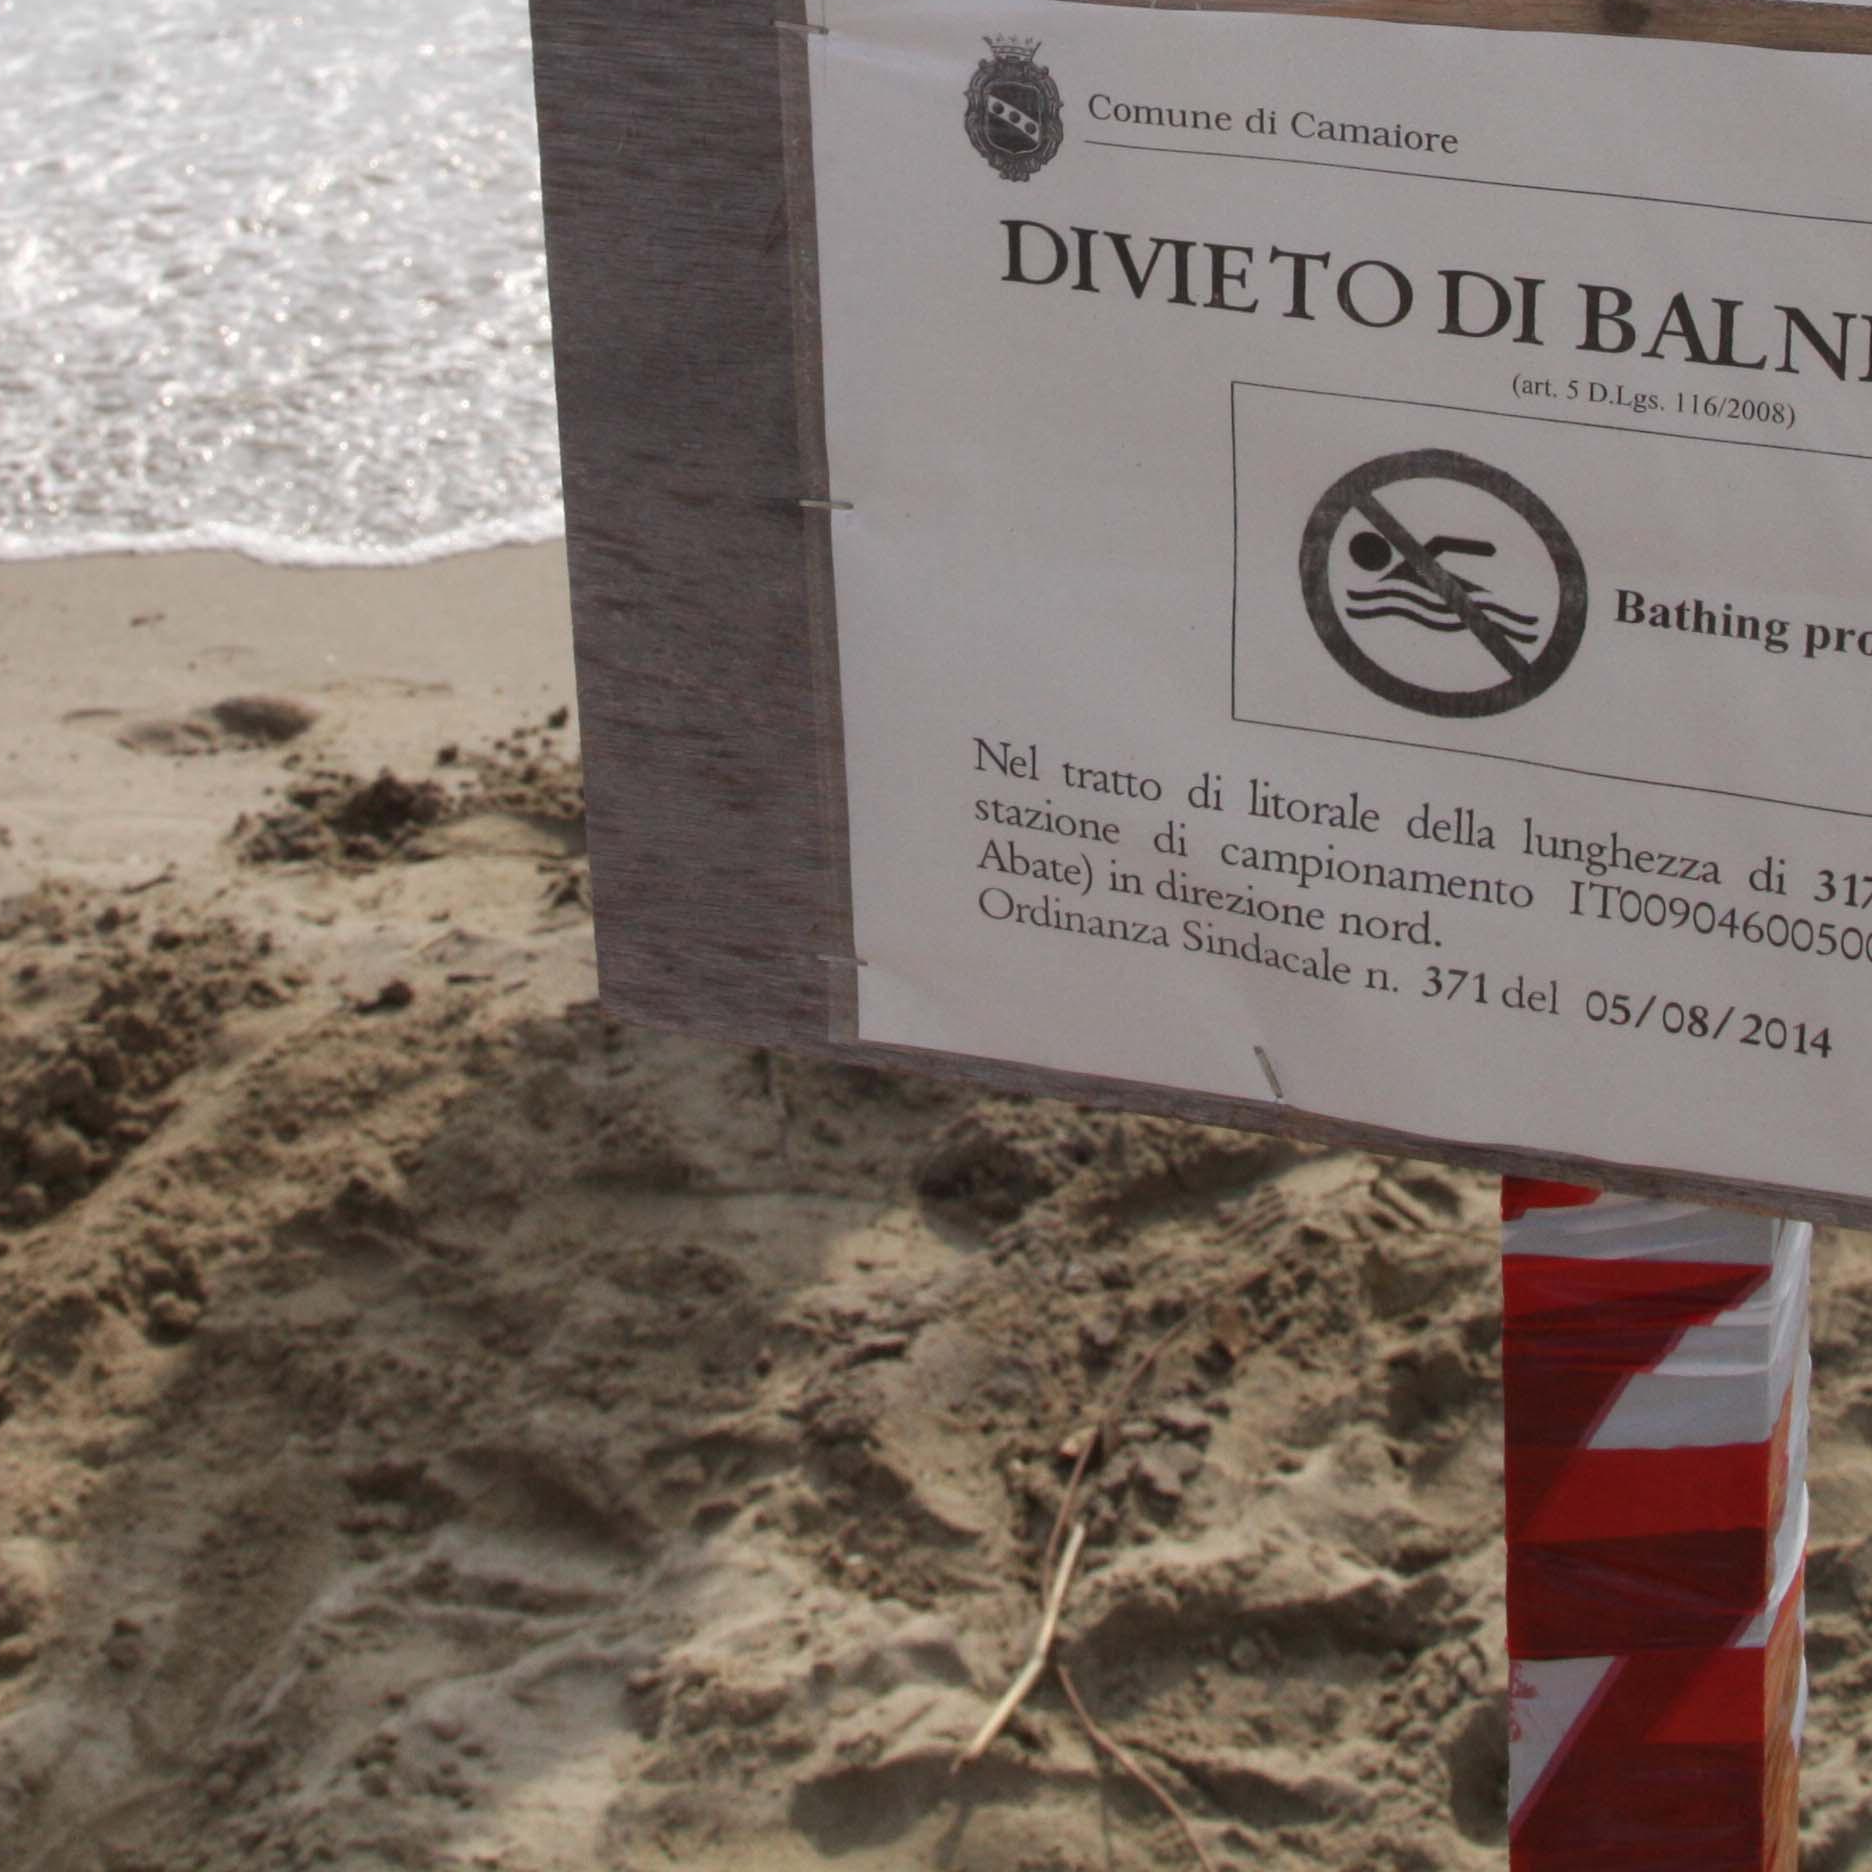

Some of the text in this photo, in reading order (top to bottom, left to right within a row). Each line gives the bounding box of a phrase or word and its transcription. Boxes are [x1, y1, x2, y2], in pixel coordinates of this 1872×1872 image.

[1087, 93, 1459, 155] Comune di Camaiore
[999, 219, 1414, 329] DIVIETO
[1436, 269, 1546, 347] DI
[1510, 372, 1798, 431] (art. 5 D.Lgs. 116/2008)
[1614, 588, 1791, 654] Bathing
[972, 737, 1040, 782] Nel
[1061, 762, 1163, 802] tratto
[1187, 771, 1224, 812] di
[1247, 778, 1380, 833] litorale
[1406, 802, 1496, 850] della
[1522, 817, 1722, 885] lunghezza
[1748, 855, 1787, 896] di
[975, 794, 1121, 845] stazione
[1153, 819, 1189, 858] di
[1220, 839, 1534, 910] campionamento
[976, 839, 1442, 948] Abate) in direzione nord.
[978, 887, 1833, 1059] Ordinanza Sindacale n. 371 del 05/08/2014
